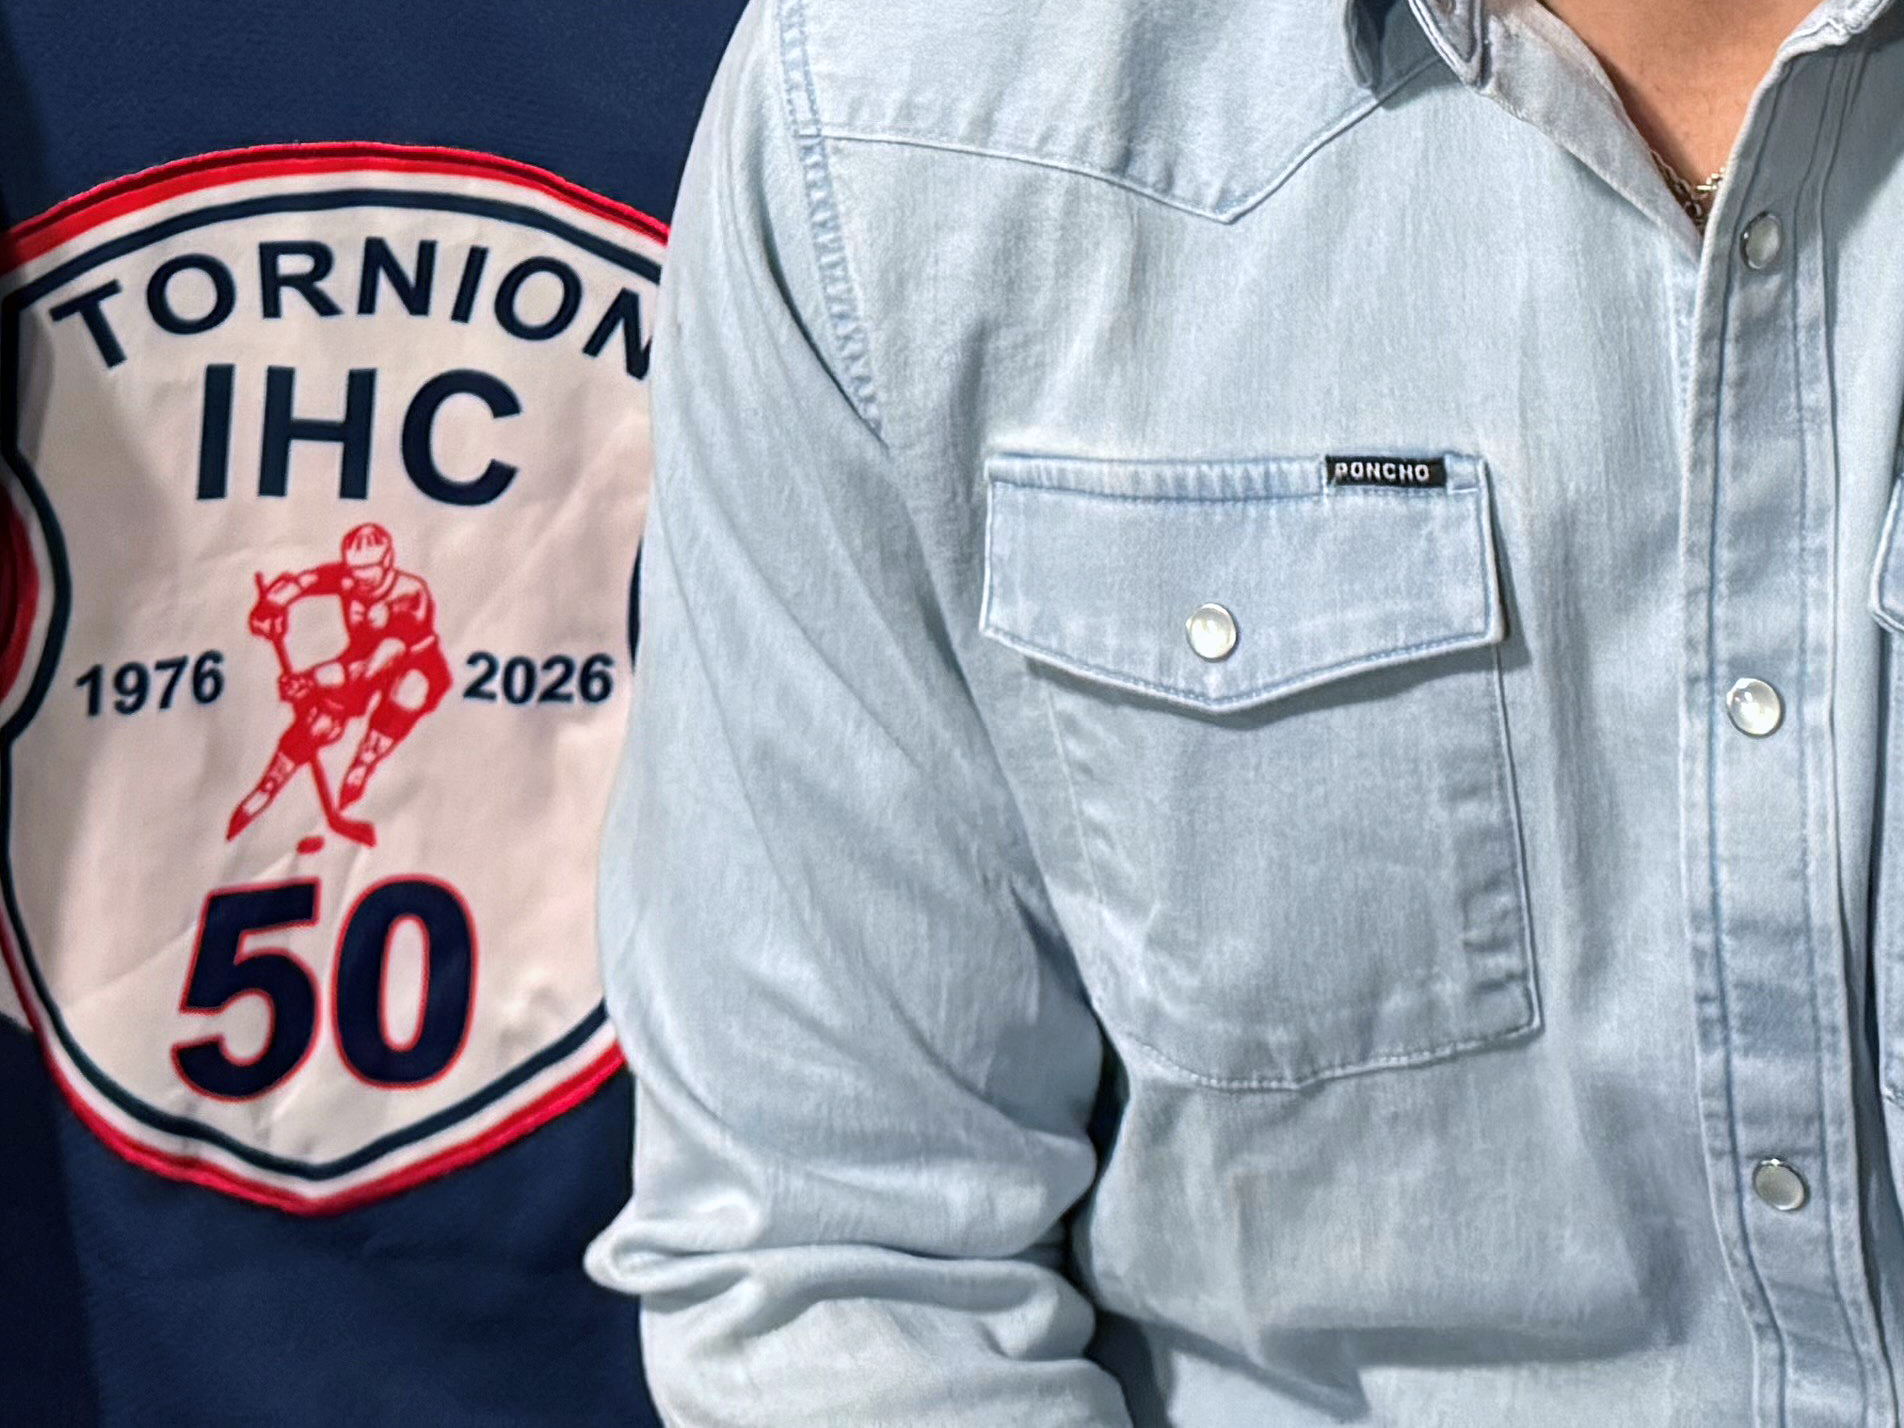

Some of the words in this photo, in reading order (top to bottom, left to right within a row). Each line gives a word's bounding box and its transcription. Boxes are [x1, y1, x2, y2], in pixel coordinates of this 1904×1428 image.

[50, 236, 652, 382] TORNION
[196, 362, 522, 506] IHC
[1335, 461, 1430, 483] PONCHO
[76, 648, 225, 717] 1976
[463, 652, 614, 706] 2026
[170, 874, 481, 1101] 50
